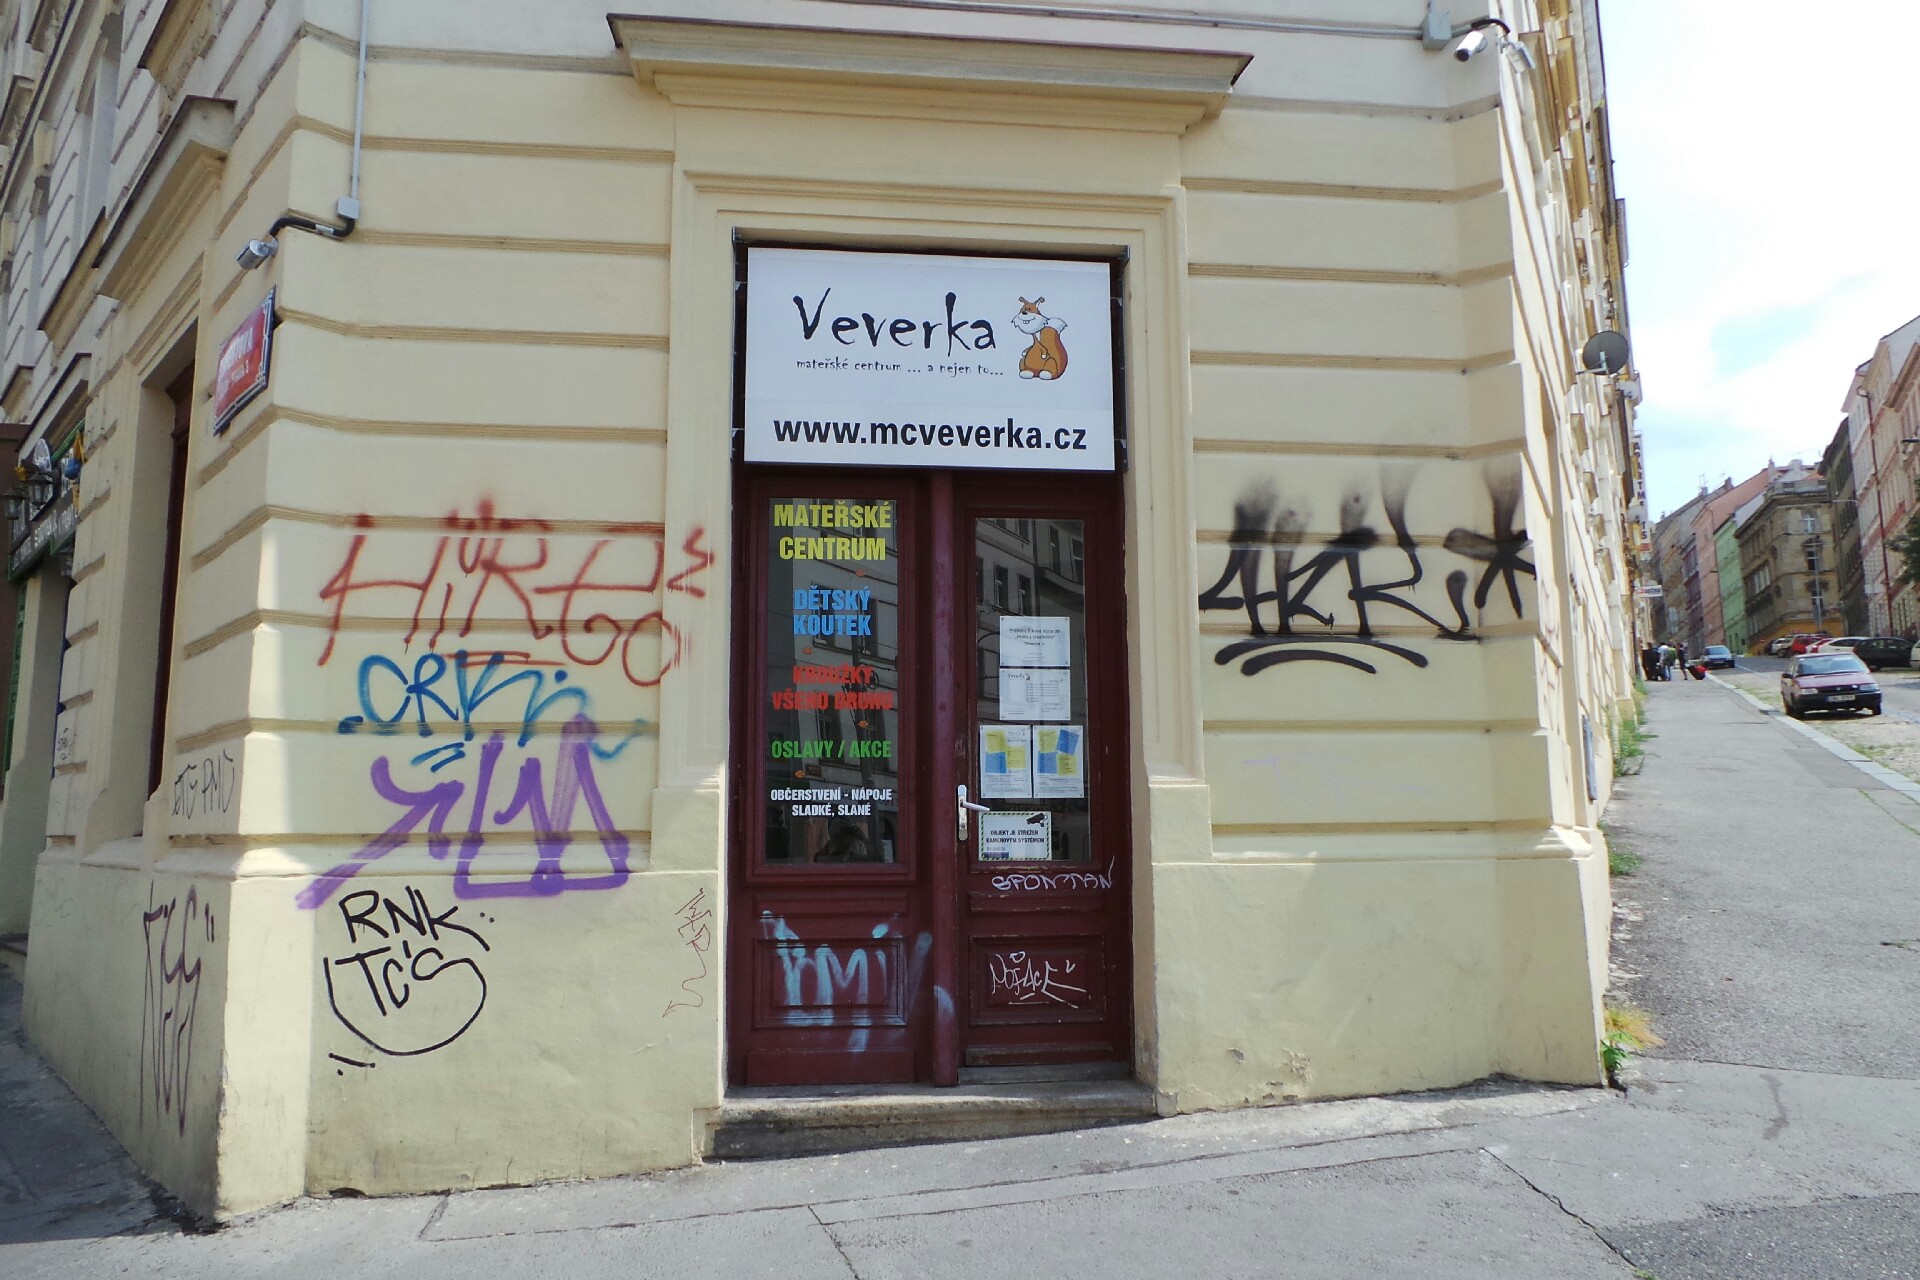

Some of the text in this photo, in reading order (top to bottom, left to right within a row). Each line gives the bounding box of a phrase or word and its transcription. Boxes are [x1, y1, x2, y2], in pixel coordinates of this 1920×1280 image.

[793, 288, 996, 356] Veverka
[796, 356, 848, 371] mateřské
[854, 359, 902, 372] centrum
[927, 364, 934, 373] a
[939, 361, 972, 377] nejen
[773, 418, 1087, 451] www.mcveverka.cz
[774, 500, 892, 528] MATEŘSKÉ
[779, 536, 886, 560] CENTRUM
[794, 585, 871, 610] DĚTSKÝ
[793, 614, 872, 636] KOUTEK
[772, 687, 893, 710] VŠEHO DRUHU
[771, 740, 834, 758] OSLAVY
[850, 740, 892, 758] AKCE
[770, 787, 841, 800] OBČERSTVENÍ
[851, 787, 892, 800] NÁPOJE
[791, 803, 871, 818] SLADKÉ, SLANÉ
